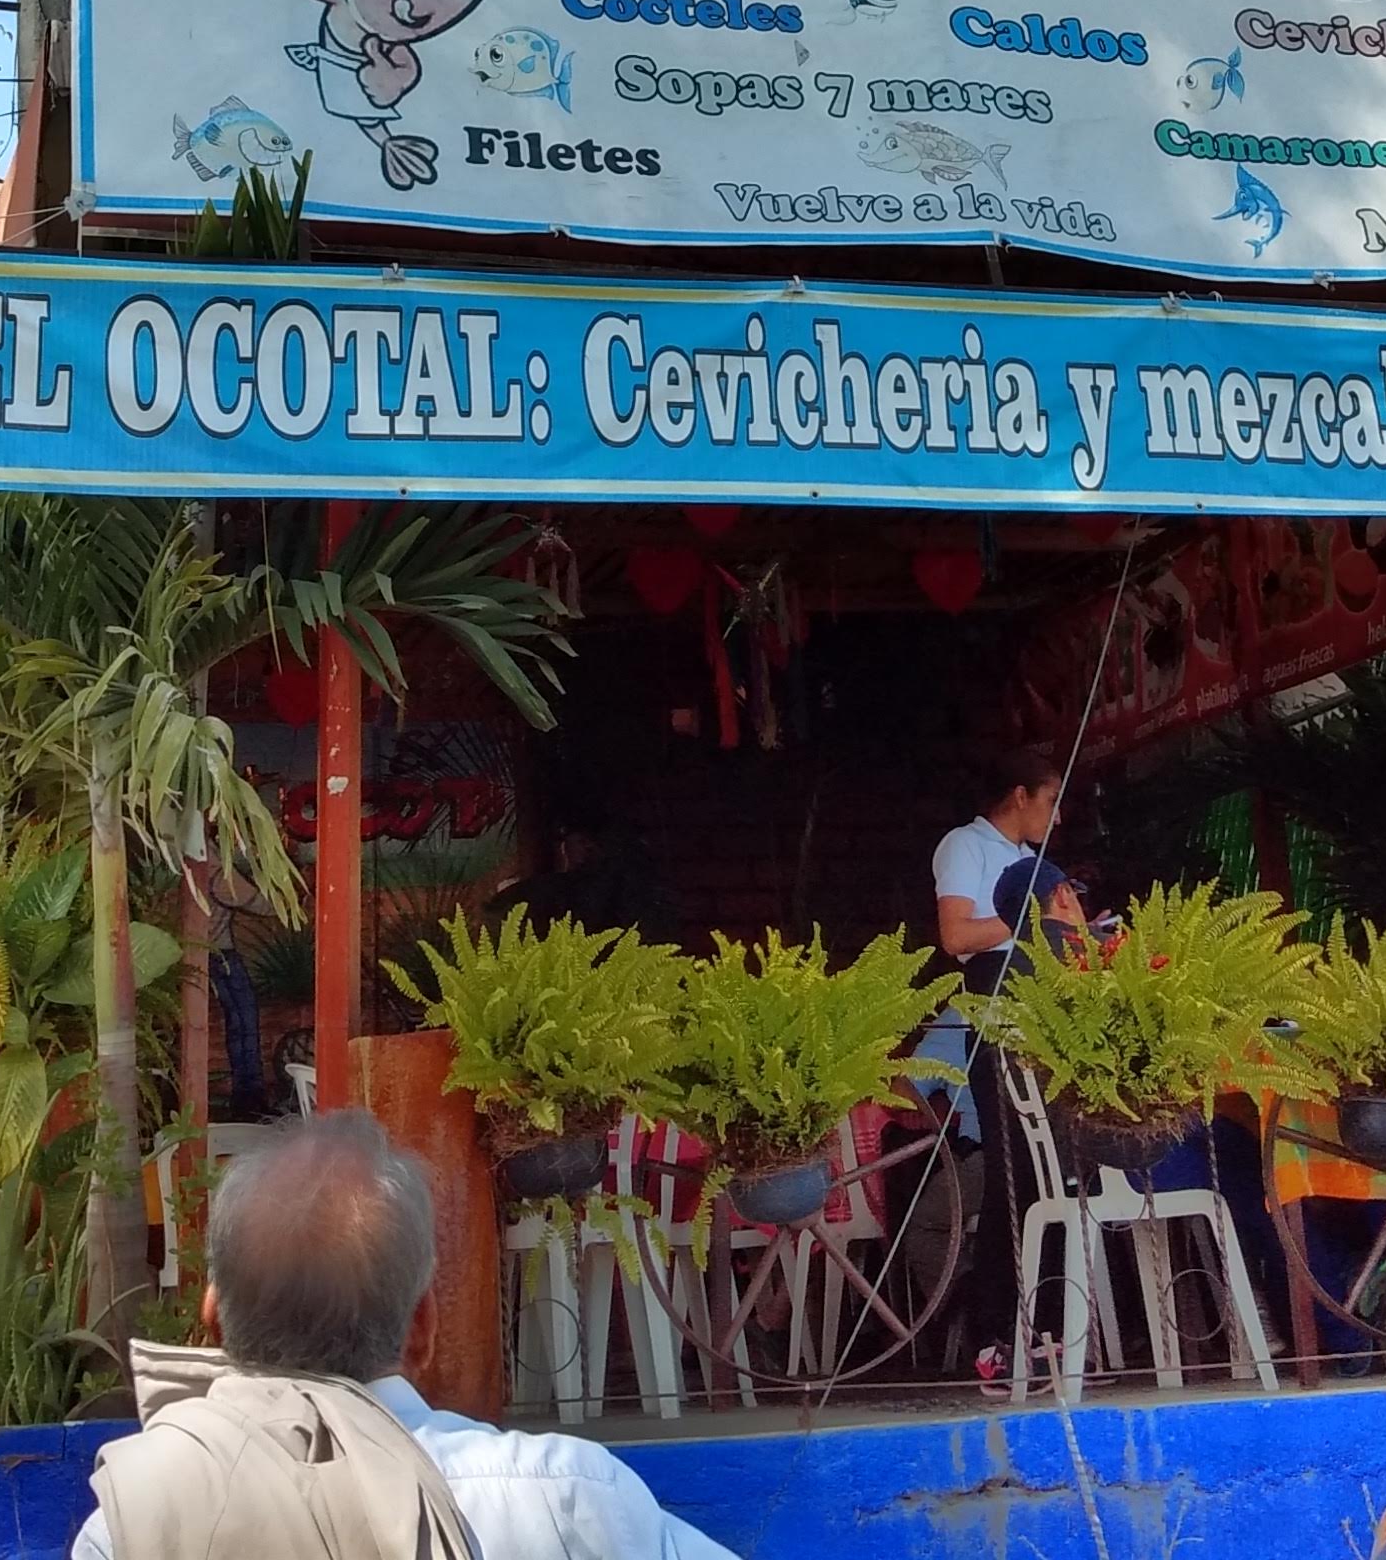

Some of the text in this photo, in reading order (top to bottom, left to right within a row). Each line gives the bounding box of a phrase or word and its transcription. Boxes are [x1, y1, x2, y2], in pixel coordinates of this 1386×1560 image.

[949, 6, 1148, 65] Caldos
[613, 54, 1053, 124] Sopas 7 mares
[463, 126, 661, 177] Filetes
[713, 182, 1116, 242] Vuelve a la vida
[105, 294, 552, 446] OCOTAL:
[581, 311, 1050, 458] Cevicheria
[1066, 362, 1117, 491] y
